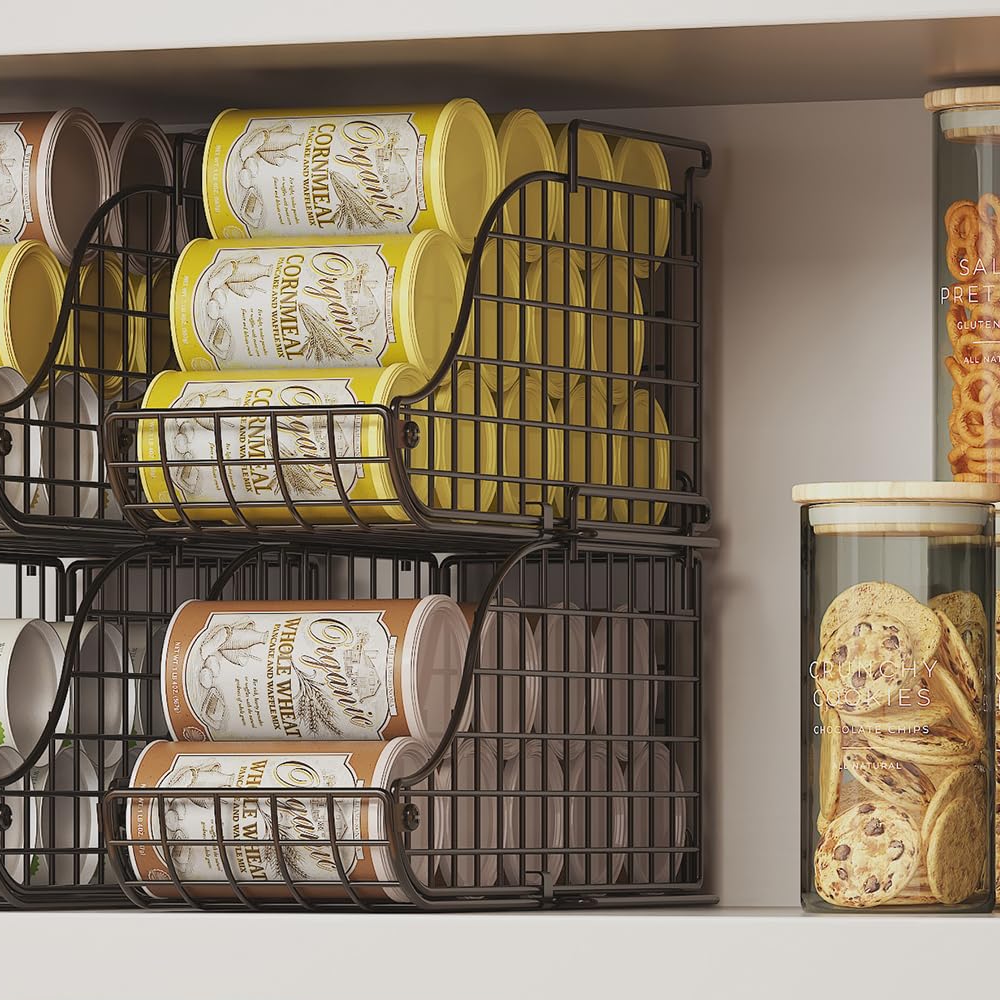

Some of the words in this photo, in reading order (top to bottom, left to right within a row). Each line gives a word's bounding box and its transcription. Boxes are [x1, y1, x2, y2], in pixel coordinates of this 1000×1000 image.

[304, 126, 316, 158] PANCAKE
[311, 124, 336, 229] CORNMEAL
[333, 121, 403, 222] Organic
[280, 255, 304, 360] CORNMEAL
[302, 252, 372, 354] Organic
[940, 285, 995, 304] PRET
[957, 321, 1000, 330] GLUTEN
[240, 444, 250, 478] WAFLE
[268, 624, 280, 659] PANCAKE
[277, 618, 301, 675] WHOLE
[300, 618, 374, 728] Organic
[810, 660, 938, 679] CRUNCHY
[267, 681, 276, 715] WAFFLE
[277, 679, 301, 737] WHEAT
[813, 688, 931, 707] COOKIES
[272, 715, 280, 730] MIX
[814, 726, 881, 734] CHOCOLATE
[889, 725, 930, 734] CHIPS
[243, 760, 267, 818] WHLE
[238, 859, 246, 873] MIX
[243, 822, 267, 880] WHEAT
